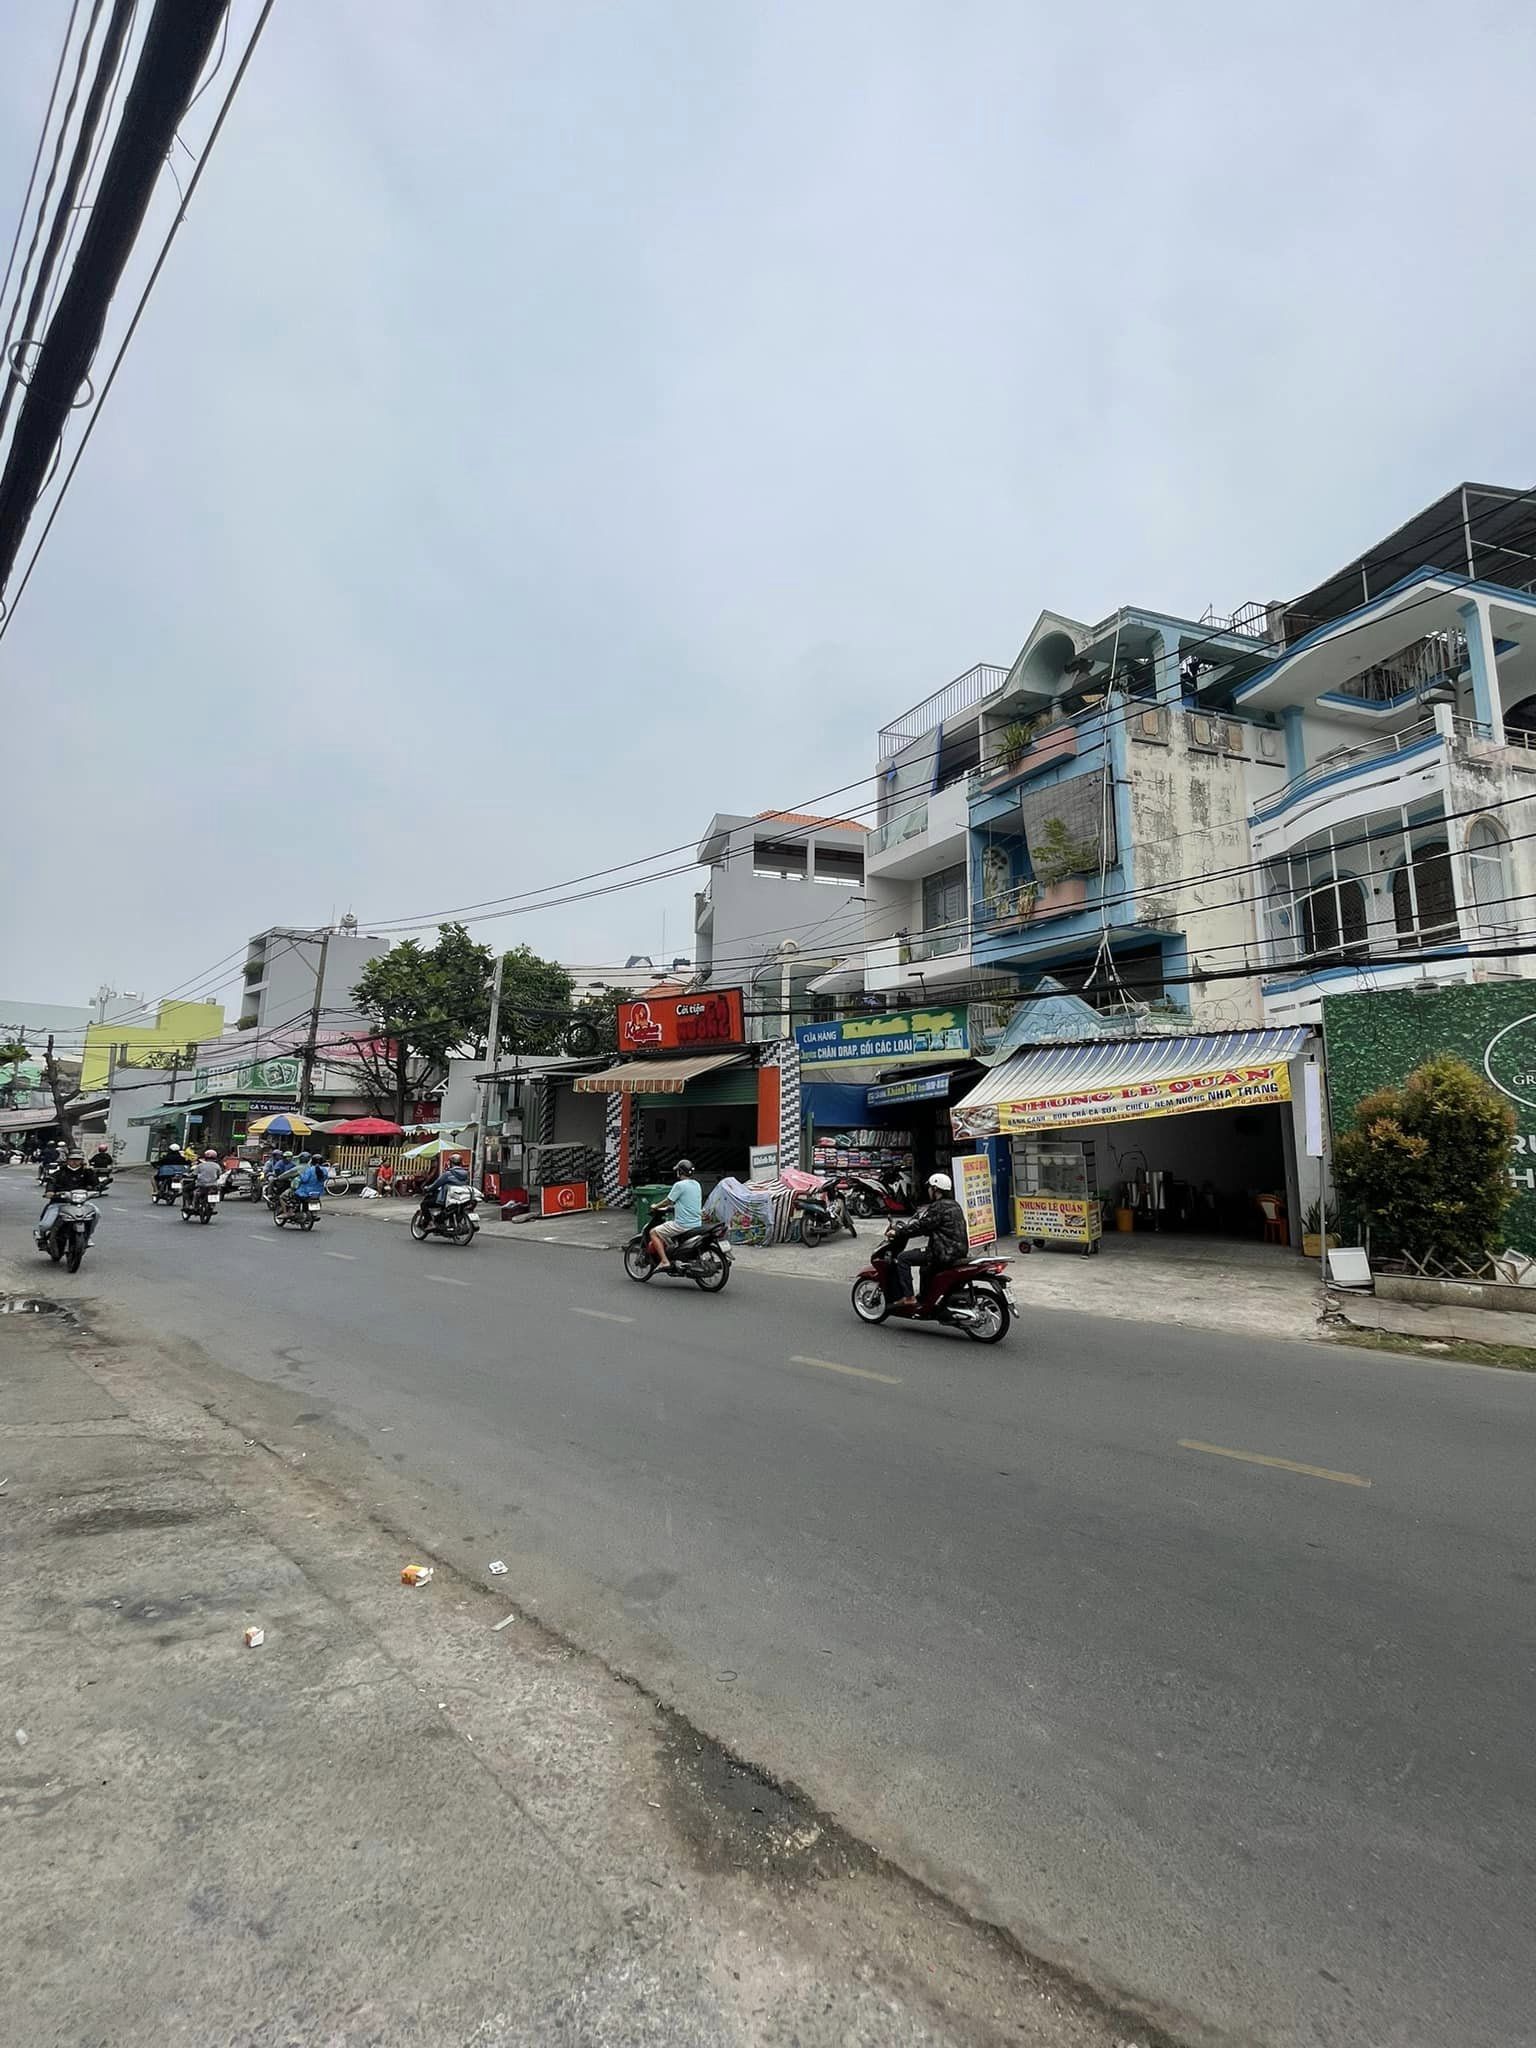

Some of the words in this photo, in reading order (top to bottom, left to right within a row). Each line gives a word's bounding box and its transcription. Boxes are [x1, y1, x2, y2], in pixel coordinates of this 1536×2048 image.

[875, 1040, 892, 1054] CÁC
[893, 1039, 913, 1055] LOẠI
[1010, 1092, 1113, 1114] NHUNG
[1121, 1082, 1162, 1099] LÊ
[1208, 1089, 1232, 1101] NHA
[1237, 1083, 1279, 1096] TRANG
